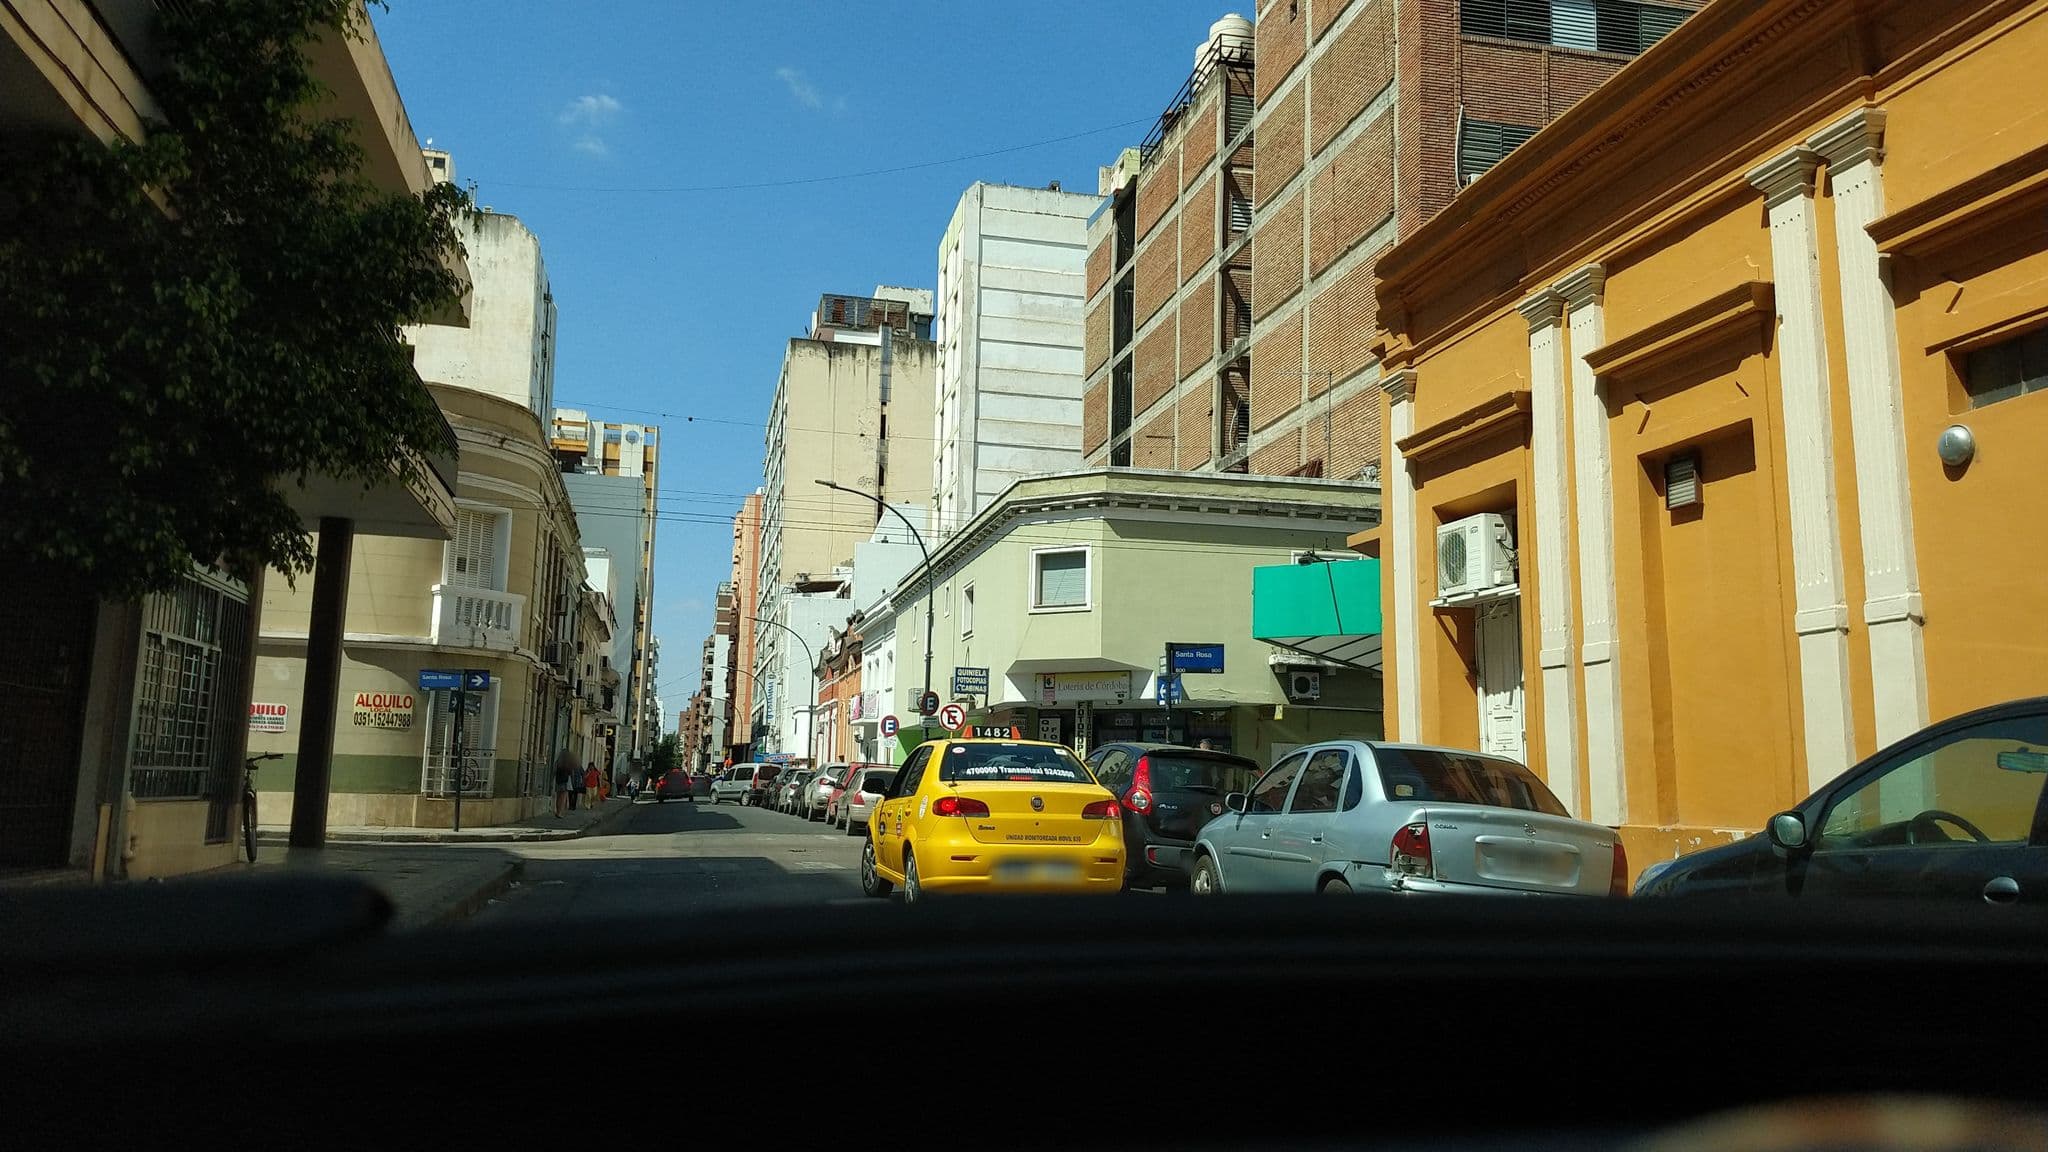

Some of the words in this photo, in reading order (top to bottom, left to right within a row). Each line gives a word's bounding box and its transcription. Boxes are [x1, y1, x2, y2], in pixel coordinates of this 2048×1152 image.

[957, 676, 987, 684] FOTOCOPIAS
[1085, 680, 1095, 690] de
[356, 693, 413, 709] ALQUILO
[926, 697, 935, 711] E
[885, 720, 895, 733] E
[976, 727, 1010, 738] 1482
[966, 766, 998, 775] 4700000
[999, 766, 1043, 775] Transmitaxi
